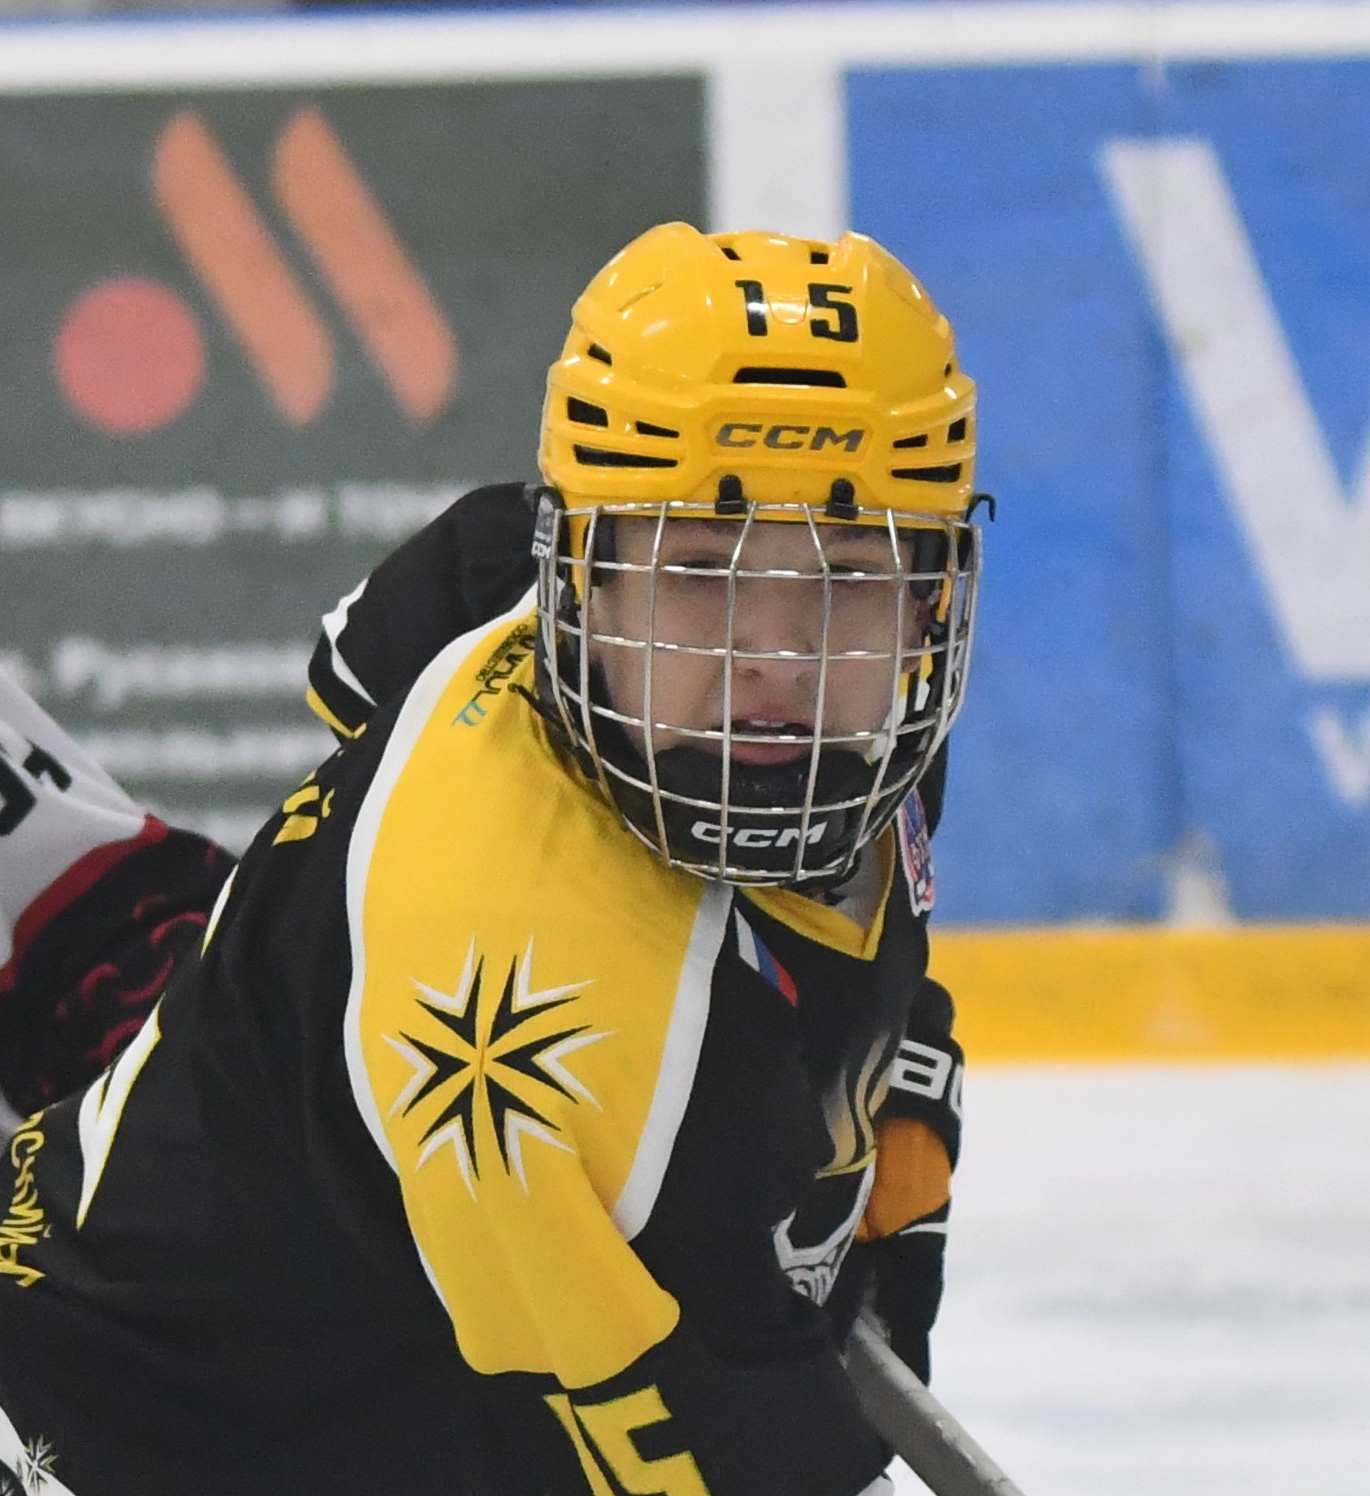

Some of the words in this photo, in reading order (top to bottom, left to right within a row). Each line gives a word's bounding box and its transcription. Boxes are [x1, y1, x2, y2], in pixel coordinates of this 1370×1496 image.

[735, 279, 859, 343] 15
[716, 423, 865, 452] CCM
[691, 820, 828, 848] CCM
